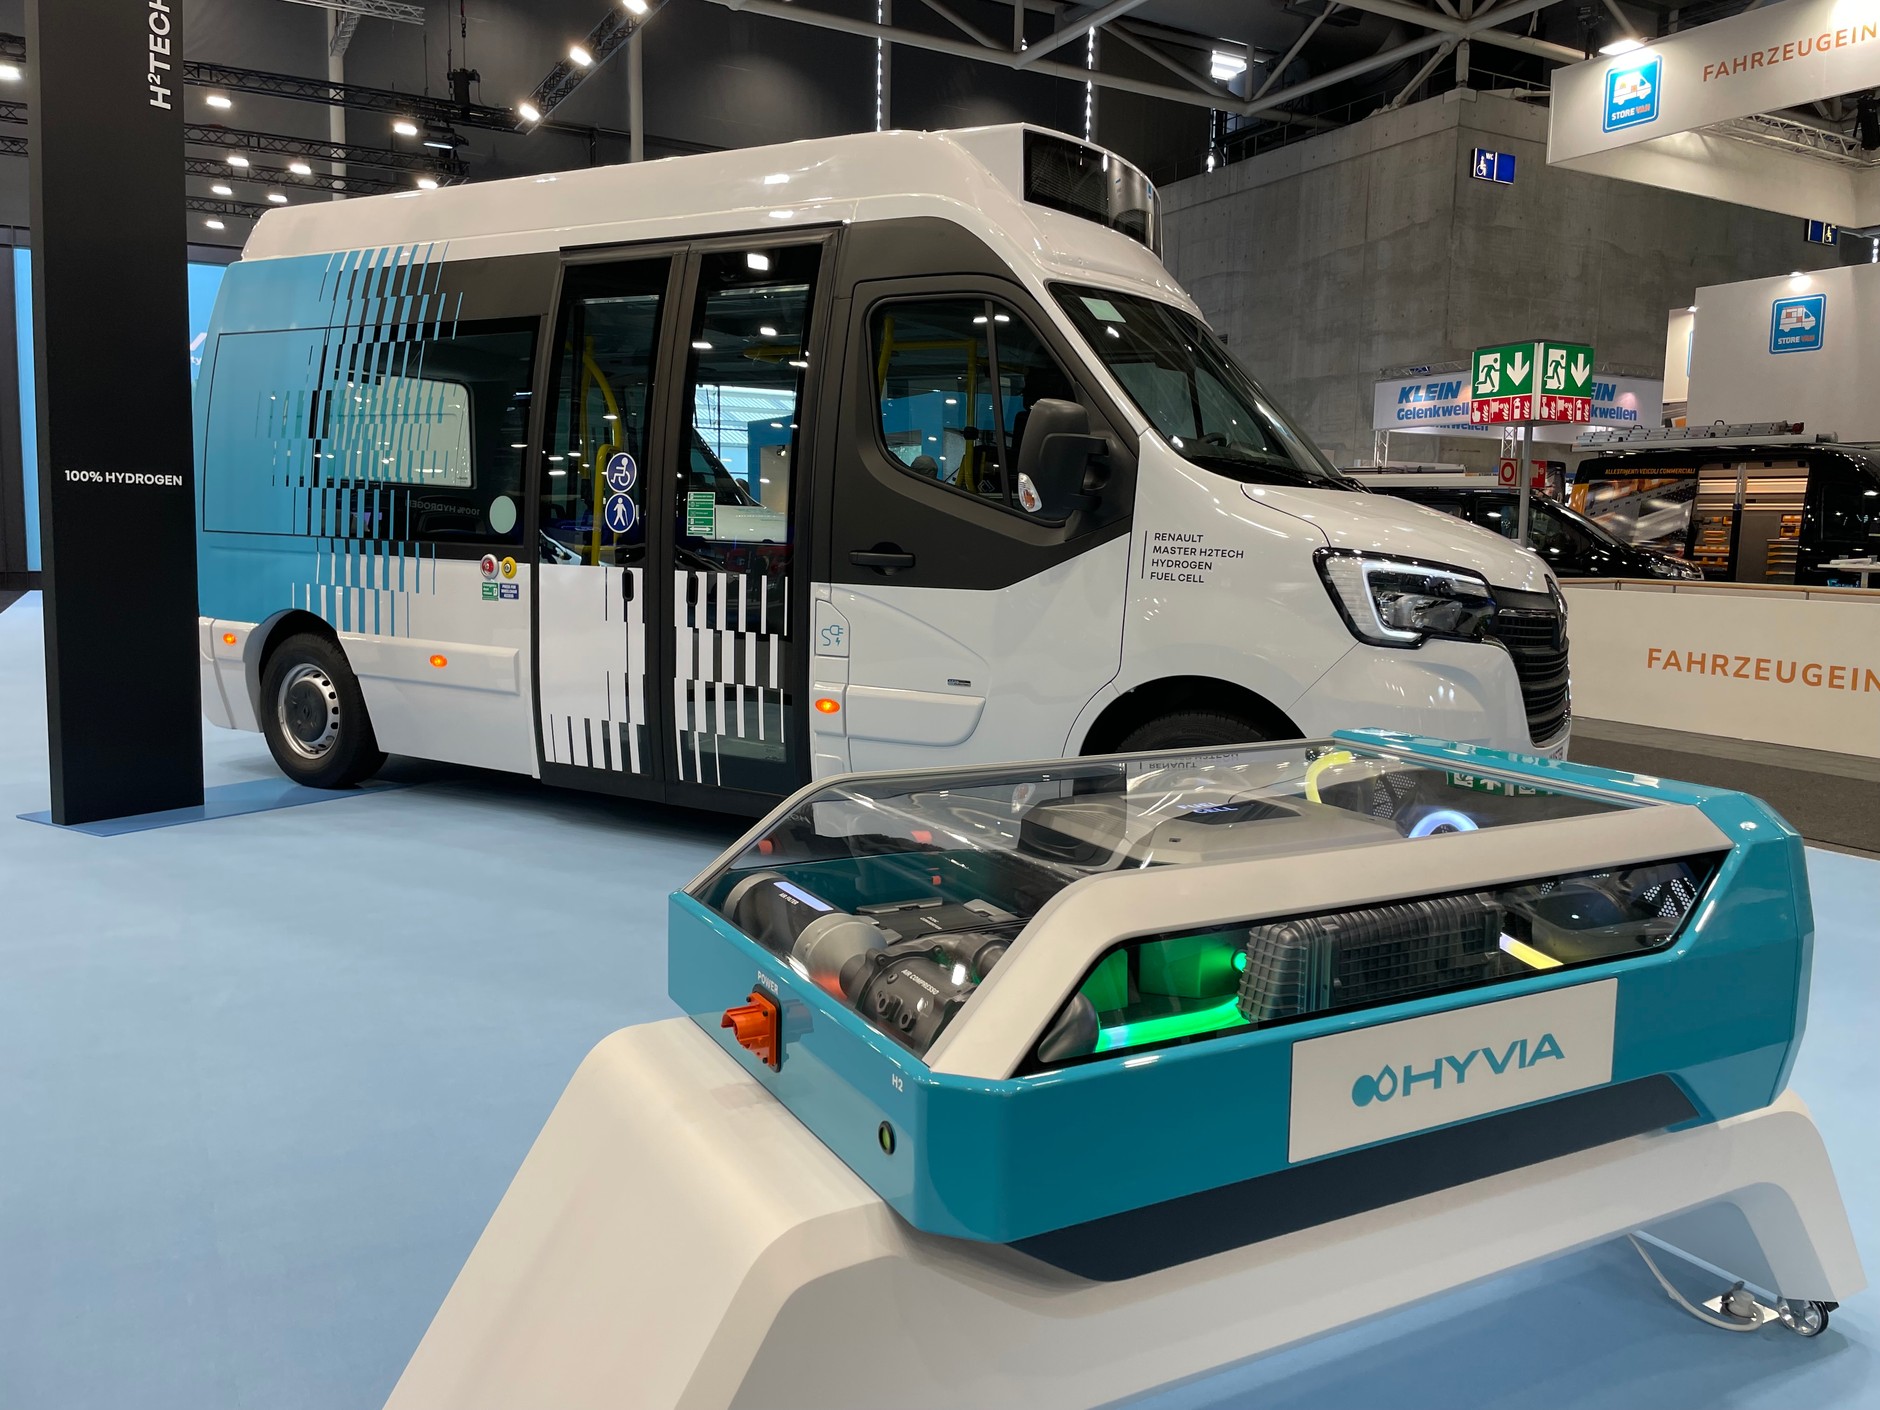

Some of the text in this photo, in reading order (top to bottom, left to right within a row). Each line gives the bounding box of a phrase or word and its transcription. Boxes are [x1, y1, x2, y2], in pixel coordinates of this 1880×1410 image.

[1703, 21, 1877, 82] FAHRZEUGEIN
[1611, 107, 1635, 121] STORE
[1485, 152, 1494, 160] WC
[1777, 336, 1801, 345] STORE
[1397, 380, 1462, 404] KLEIN
[1396, 402, 1470, 420] Gelenkwell
[1590, 404, 1637, 421] kwellen
[64, 469, 183, 486] 100% HYDROGEN
[1640, 467, 1659, 475] VEICOLI
[1660, 467, 1696, 475] COMMERCIALI
[1154, 532, 1204, 543] RENAULT
[1152, 545, 1244, 559] MASTER H2TECH
[1151, 558, 1213, 570] HYDROGEN
[1150, 571, 1205, 583] FUEL CELL
[1647, 647, 1880, 693] FAHRZEUGEIN
[901, 969, 913, 977] AIR
[757, 970, 779, 996] POWER
[1402, 1033, 1565, 1098] HYVIA
[892, 1073, 904, 1093] H2
